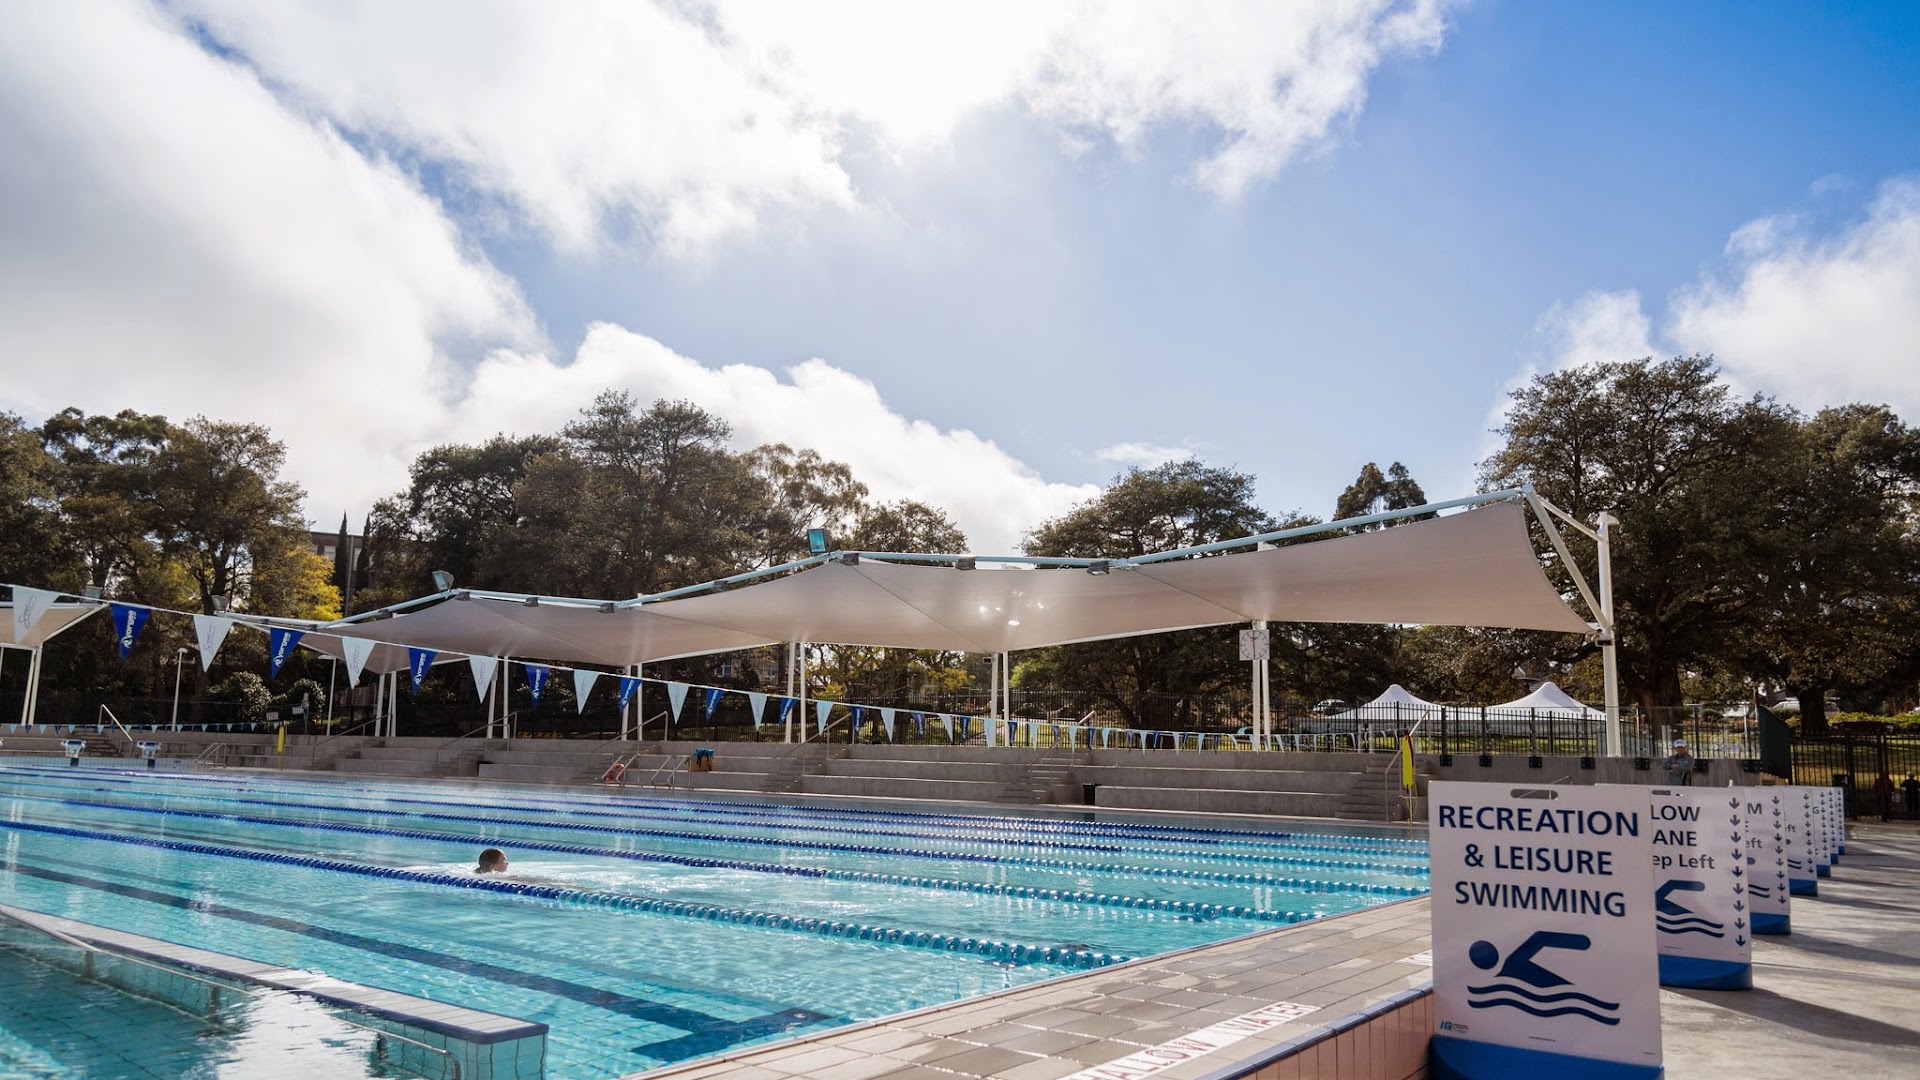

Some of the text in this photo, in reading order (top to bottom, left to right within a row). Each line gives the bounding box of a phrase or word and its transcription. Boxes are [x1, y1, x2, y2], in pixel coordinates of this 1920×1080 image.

[1439, 805, 1639, 837] RECREATION
[1651, 804, 1701, 822] LOW
[1653, 829, 1697, 847] ANE
[1464, 843, 1613, 876] & LEISURE
[1653, 853, 1715, 869] ep Left
[1455, 880, 1626, 917] SWIMMING
[1220, 1002, 1310, 1036] WATER
